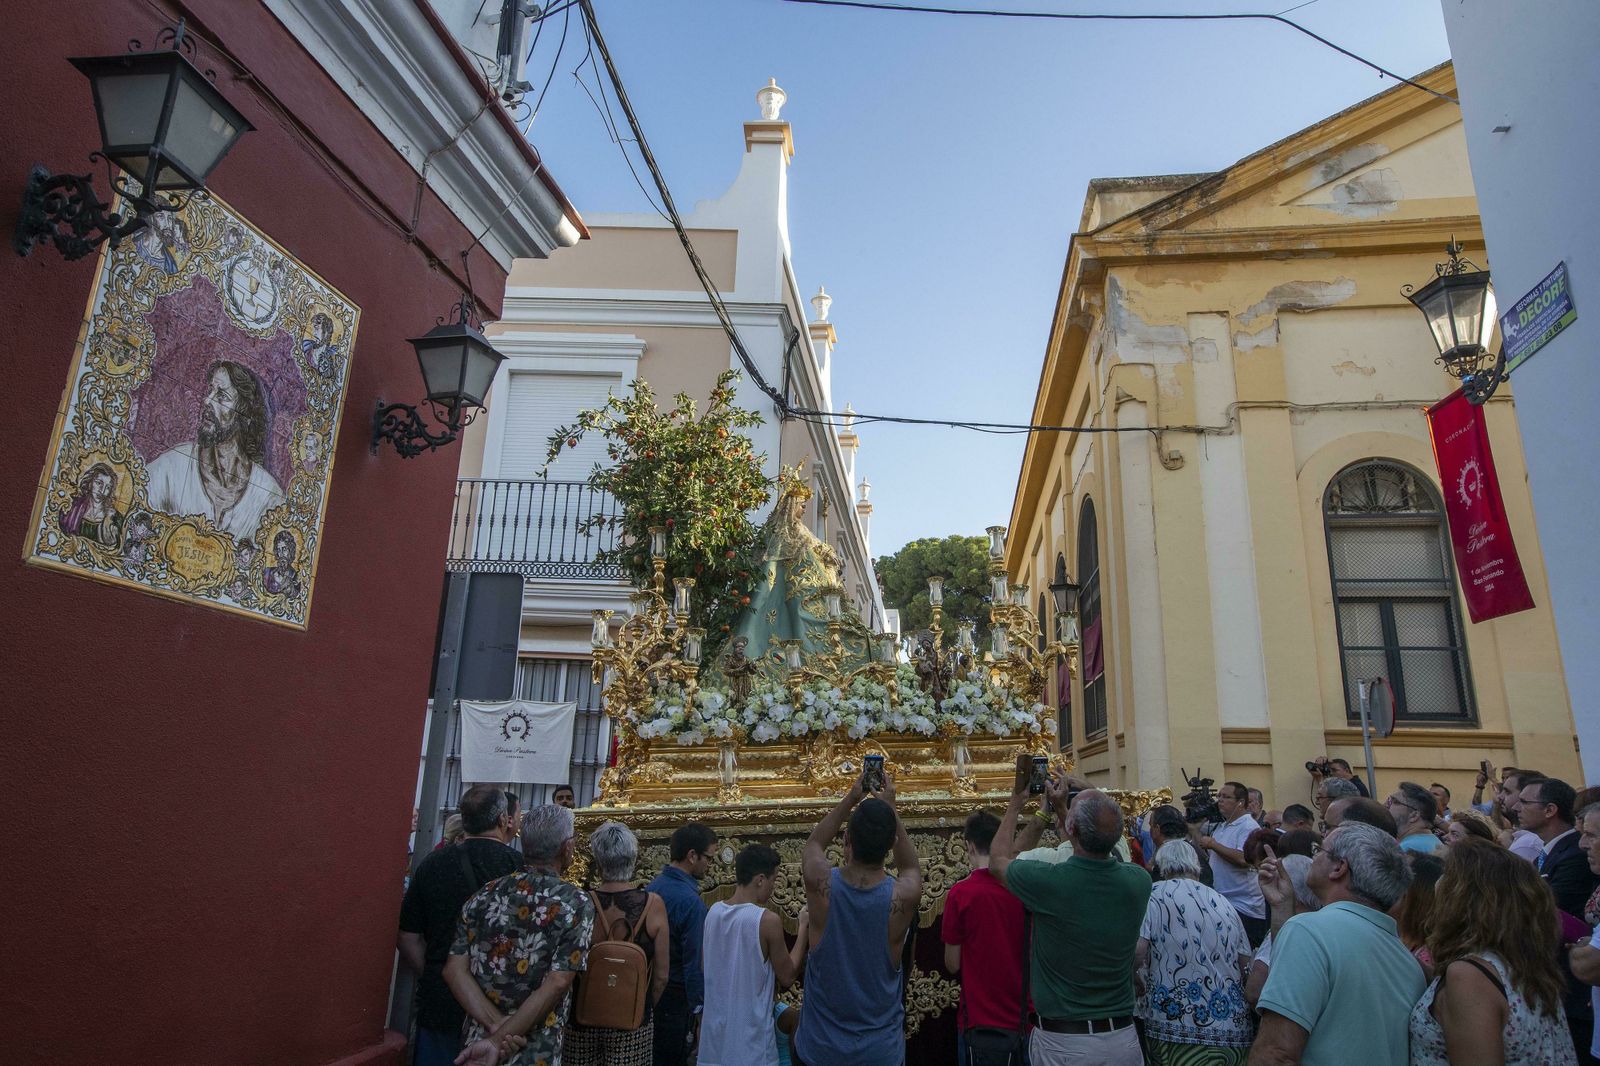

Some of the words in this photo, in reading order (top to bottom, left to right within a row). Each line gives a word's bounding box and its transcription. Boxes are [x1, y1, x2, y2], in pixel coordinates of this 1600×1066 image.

[1516, 289, 1538, 311] REFORMAS
[1543, 266, 1563, 288] PINTURAS
[1519, 275, 1564, 326] DECORE
